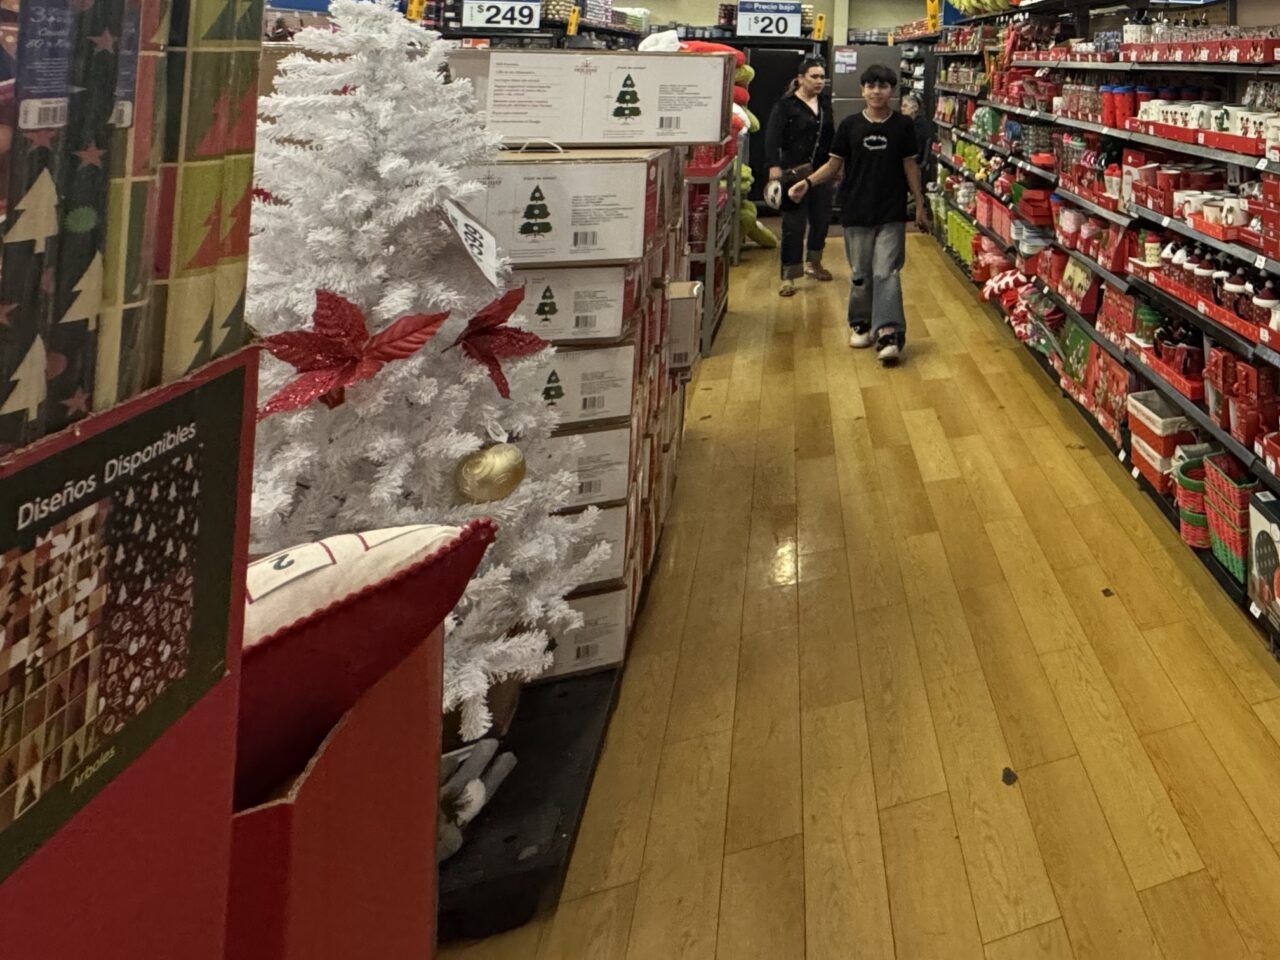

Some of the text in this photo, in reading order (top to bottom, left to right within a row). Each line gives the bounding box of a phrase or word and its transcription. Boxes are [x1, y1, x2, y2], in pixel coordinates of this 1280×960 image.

[477, 5, 534, 25] $249
[754, 3, 777, 11] Precio
[778, 3, 795, 12] bajo
[753, 16, 789, 34] $20
[17, 422, 196, 531] Diseños Disponibles
[269, 553, 295, 570] 2
